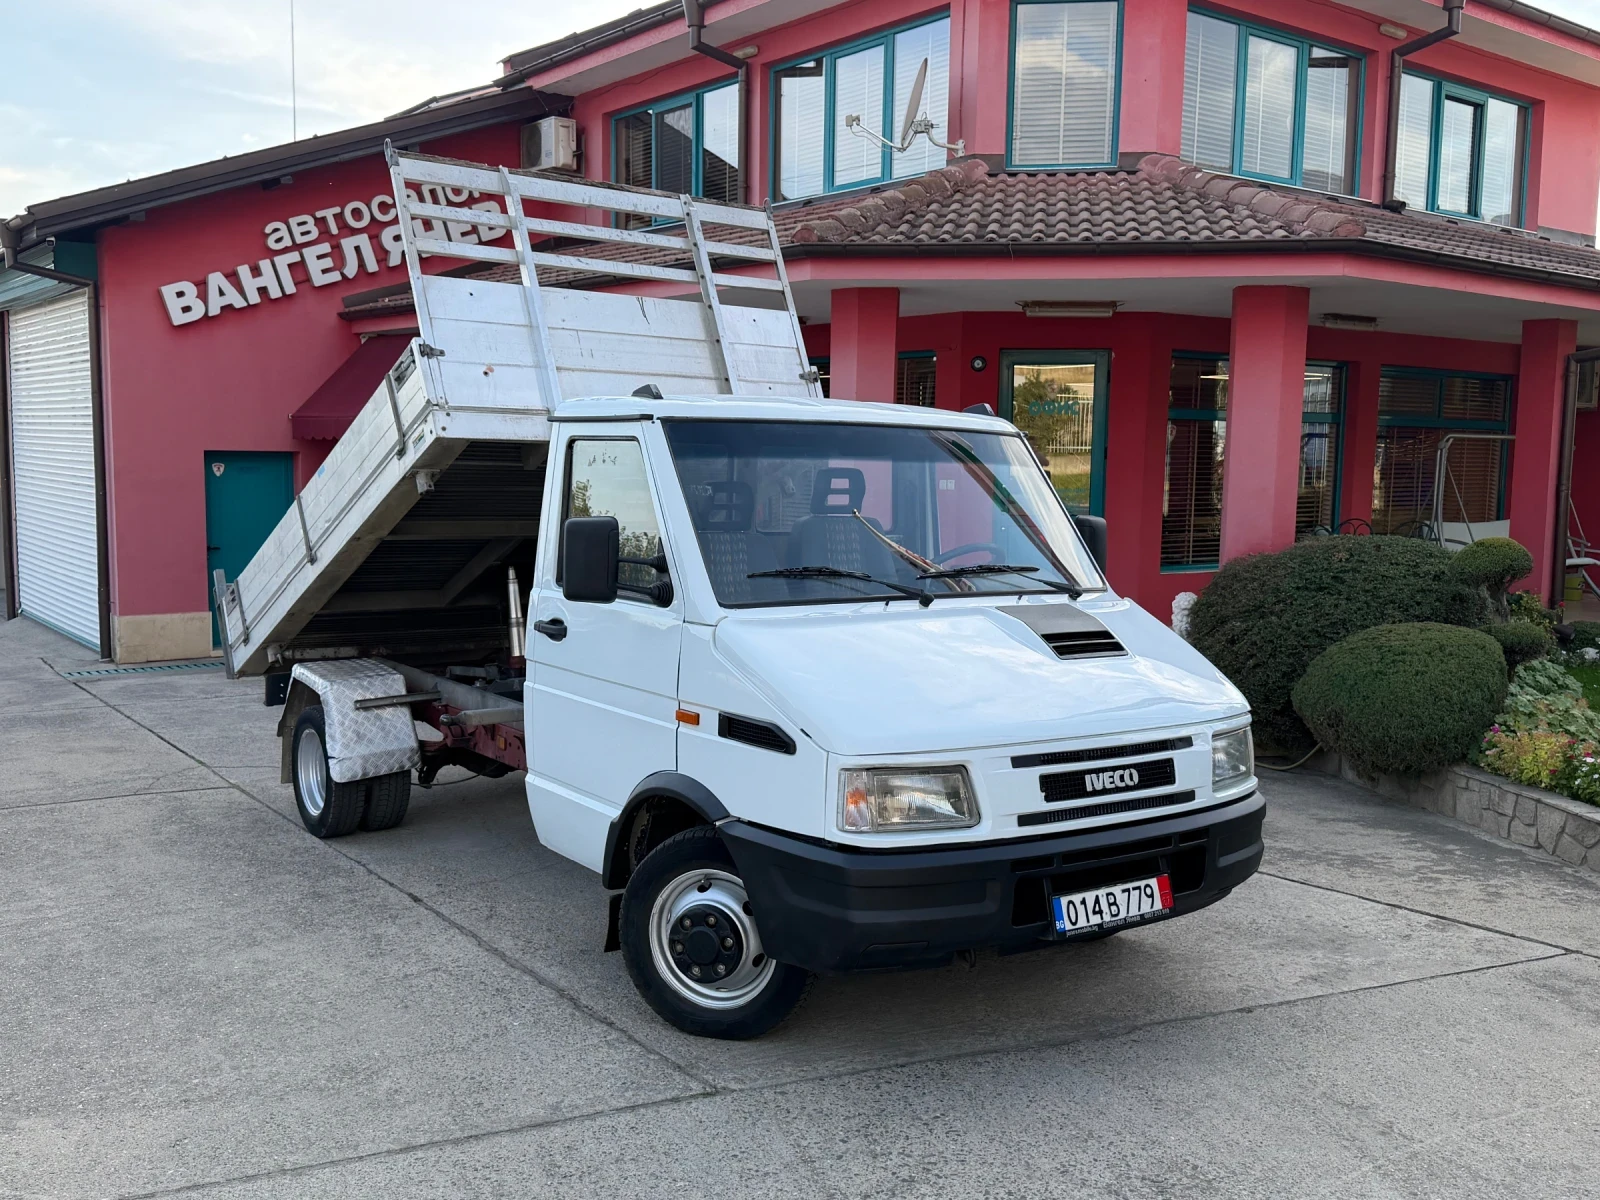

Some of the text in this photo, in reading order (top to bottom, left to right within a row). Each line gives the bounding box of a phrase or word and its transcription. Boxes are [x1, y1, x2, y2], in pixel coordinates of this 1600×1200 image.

[159, 233, 379, 327] ВАНГЕЛ
[1028, 400, 1080, 416] ОФИС
[1085, 768, 1139, 792] IVECO
[1066, 883, 1155, 927] 014B779
[1055, 920, 1065, 931] BG
